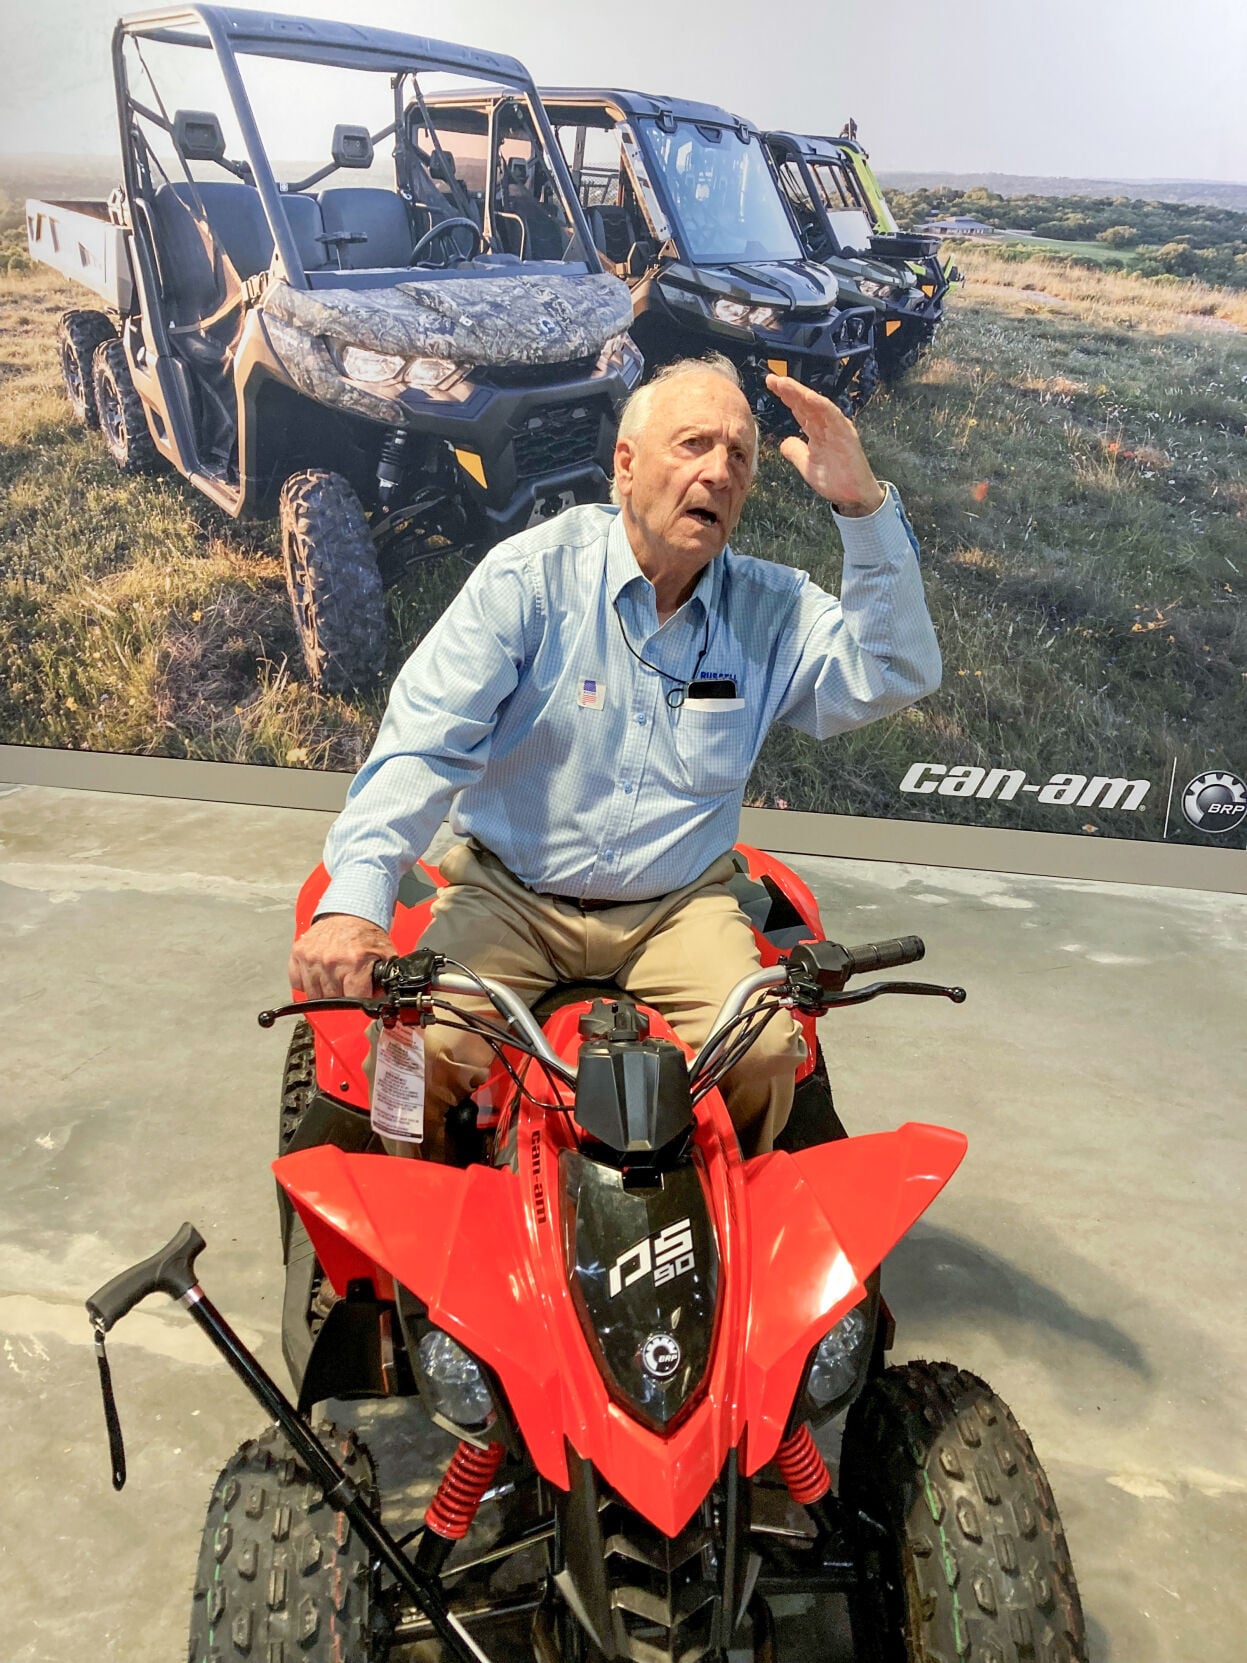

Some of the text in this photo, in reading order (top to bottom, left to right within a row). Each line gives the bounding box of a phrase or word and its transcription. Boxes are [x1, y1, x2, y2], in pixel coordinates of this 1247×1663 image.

[899, 762, 1151, 811] can-am
[1207, 803, 1246, 815] BRP
[531, 1130, 547, 1225] can-am
[653, 1252, 696, 1288] 90
[658, 1354, 678, 1363] BRP
